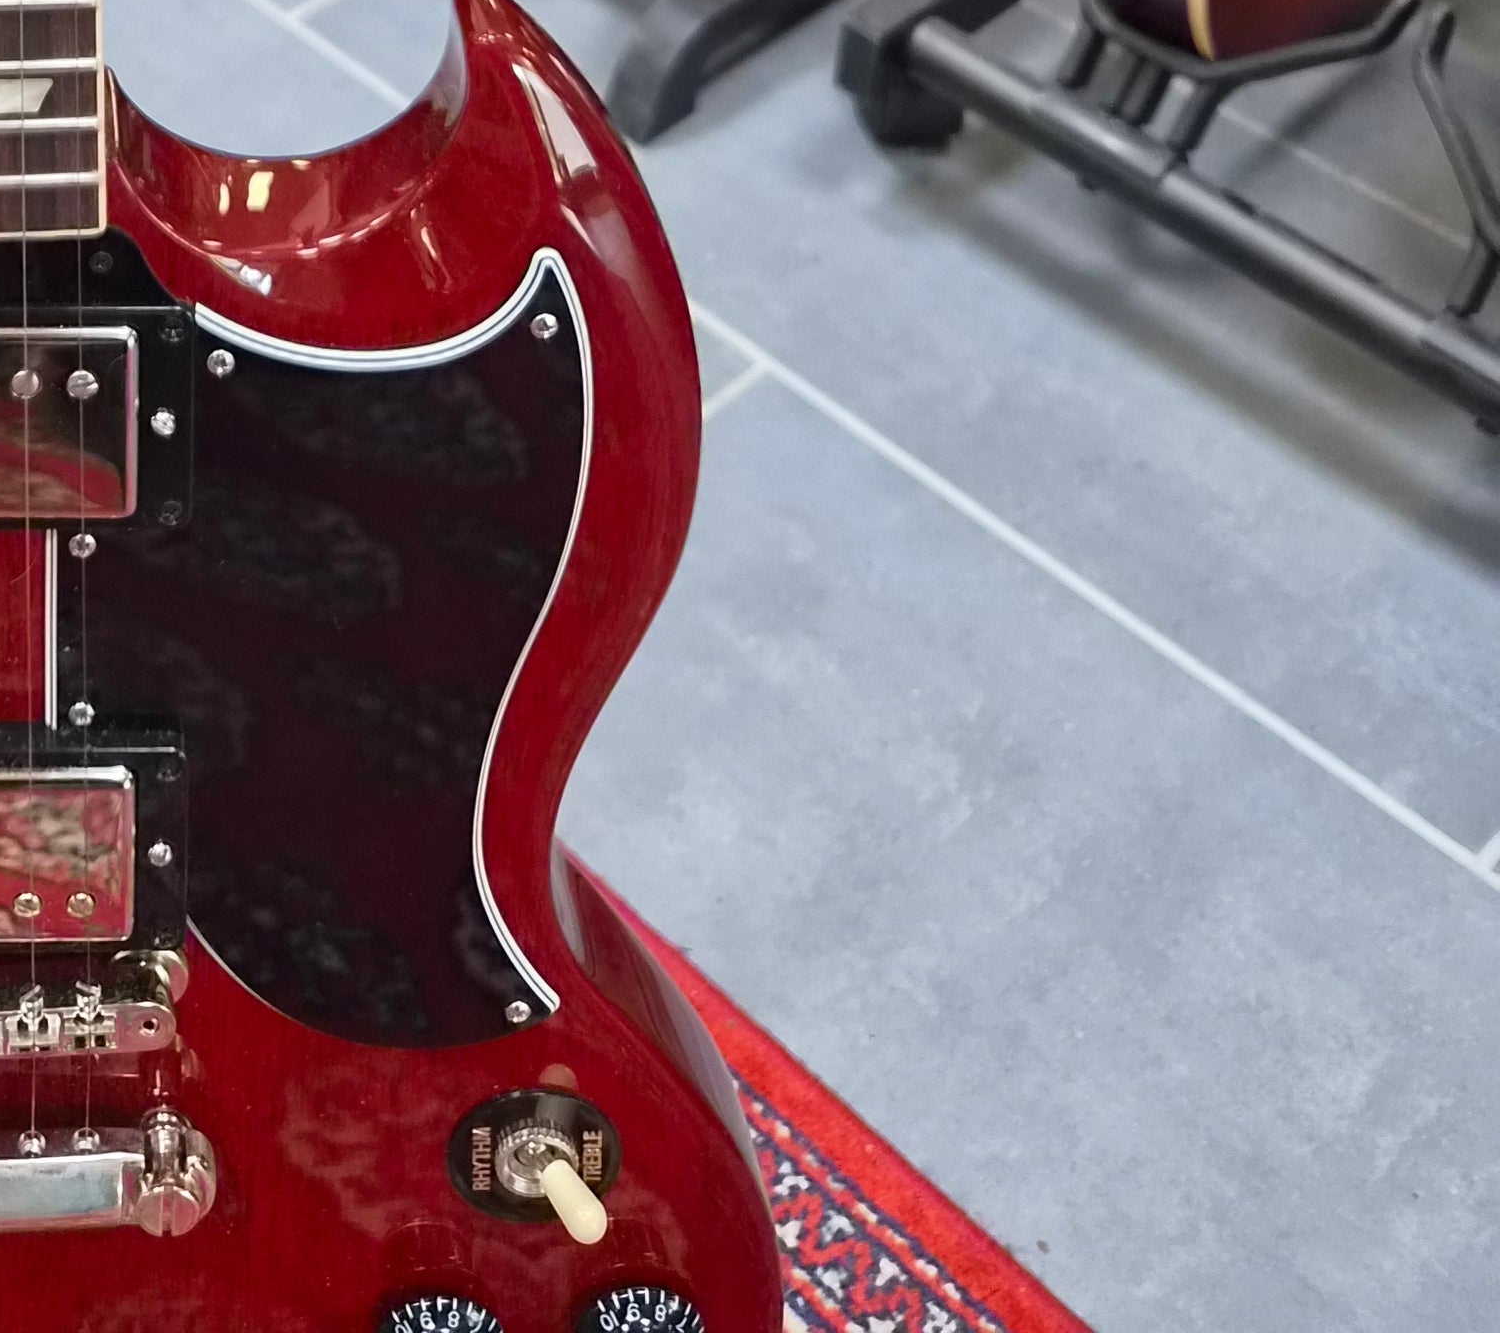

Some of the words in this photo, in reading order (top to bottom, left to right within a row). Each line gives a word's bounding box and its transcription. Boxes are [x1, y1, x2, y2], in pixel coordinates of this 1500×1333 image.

[472, 1127, 492, 1191] RHYTHM
[582, 1130, 603, 1182] TREBLE
[447, 1310, 460, 1328] 8
[654, 1304, 667, 1322] 8
